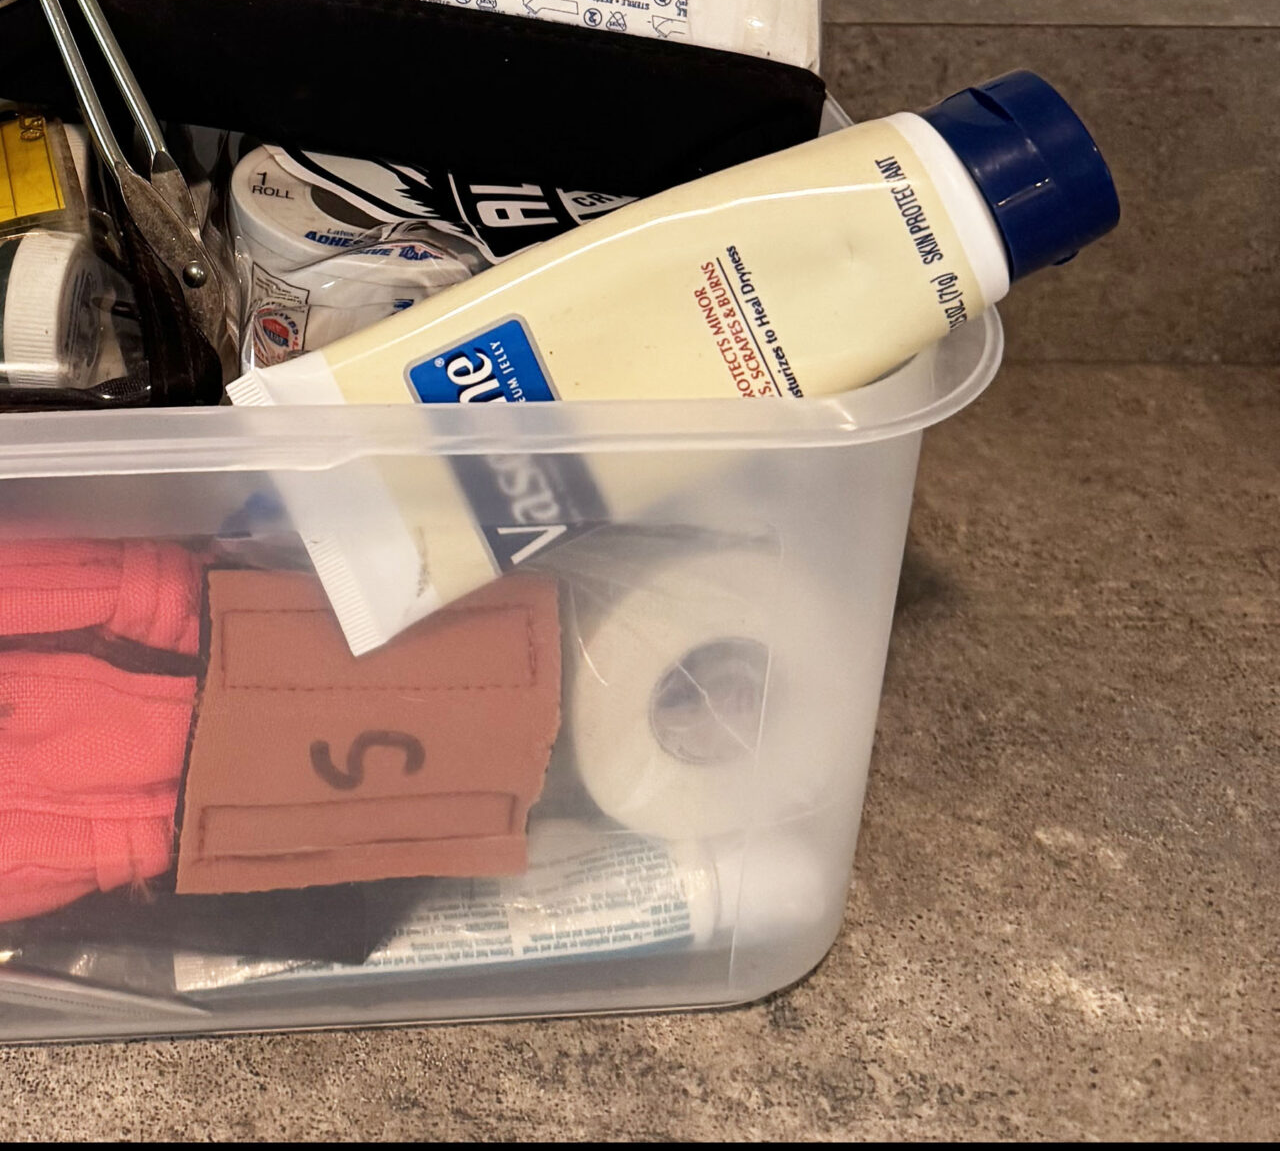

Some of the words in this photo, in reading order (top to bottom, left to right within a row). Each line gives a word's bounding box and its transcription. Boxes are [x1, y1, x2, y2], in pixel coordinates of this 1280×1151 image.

[251, 184, 296, 200] ROLL
[256, 170, 269, 186] 1
[912, 232, 945, 265] SKIN
[700, 260, 731, 308] BURNS
[725, 245, 756, 296] Dryness
[693, 285, 726, 336] MINOR
[723, 307, 737, 320] &
[744, 296, 771, 328] Heal
[727, 319, 766, 380] SCRAPES
[764, 328, 779, 345] to
[489, 340, 516, 375] JELLY
[716, 337, 756, 399] ROTECTS
